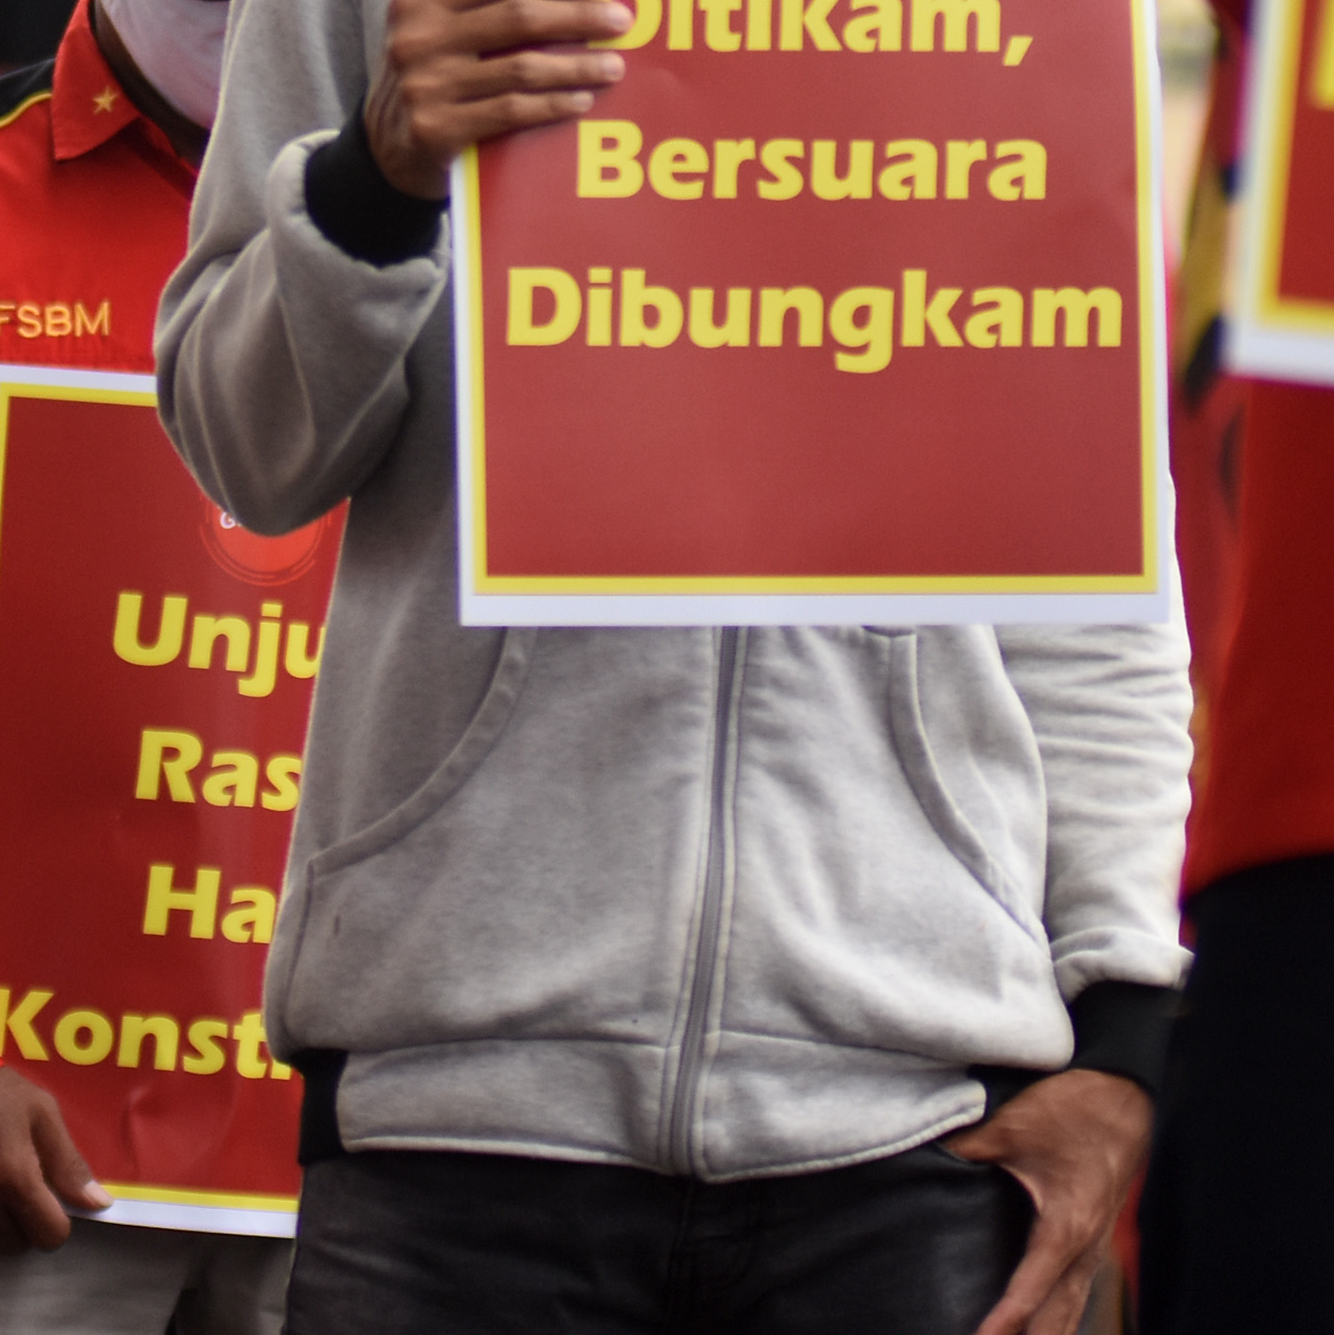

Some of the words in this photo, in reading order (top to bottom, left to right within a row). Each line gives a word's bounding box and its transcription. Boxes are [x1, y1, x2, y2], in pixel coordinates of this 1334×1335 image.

[577, 120, 1048, 201] Bersuara
[507, 266, 1123, 374] Dibungkam
[135, 728, 303, 812] Ras
[143, 864, 278, 944] Ha
